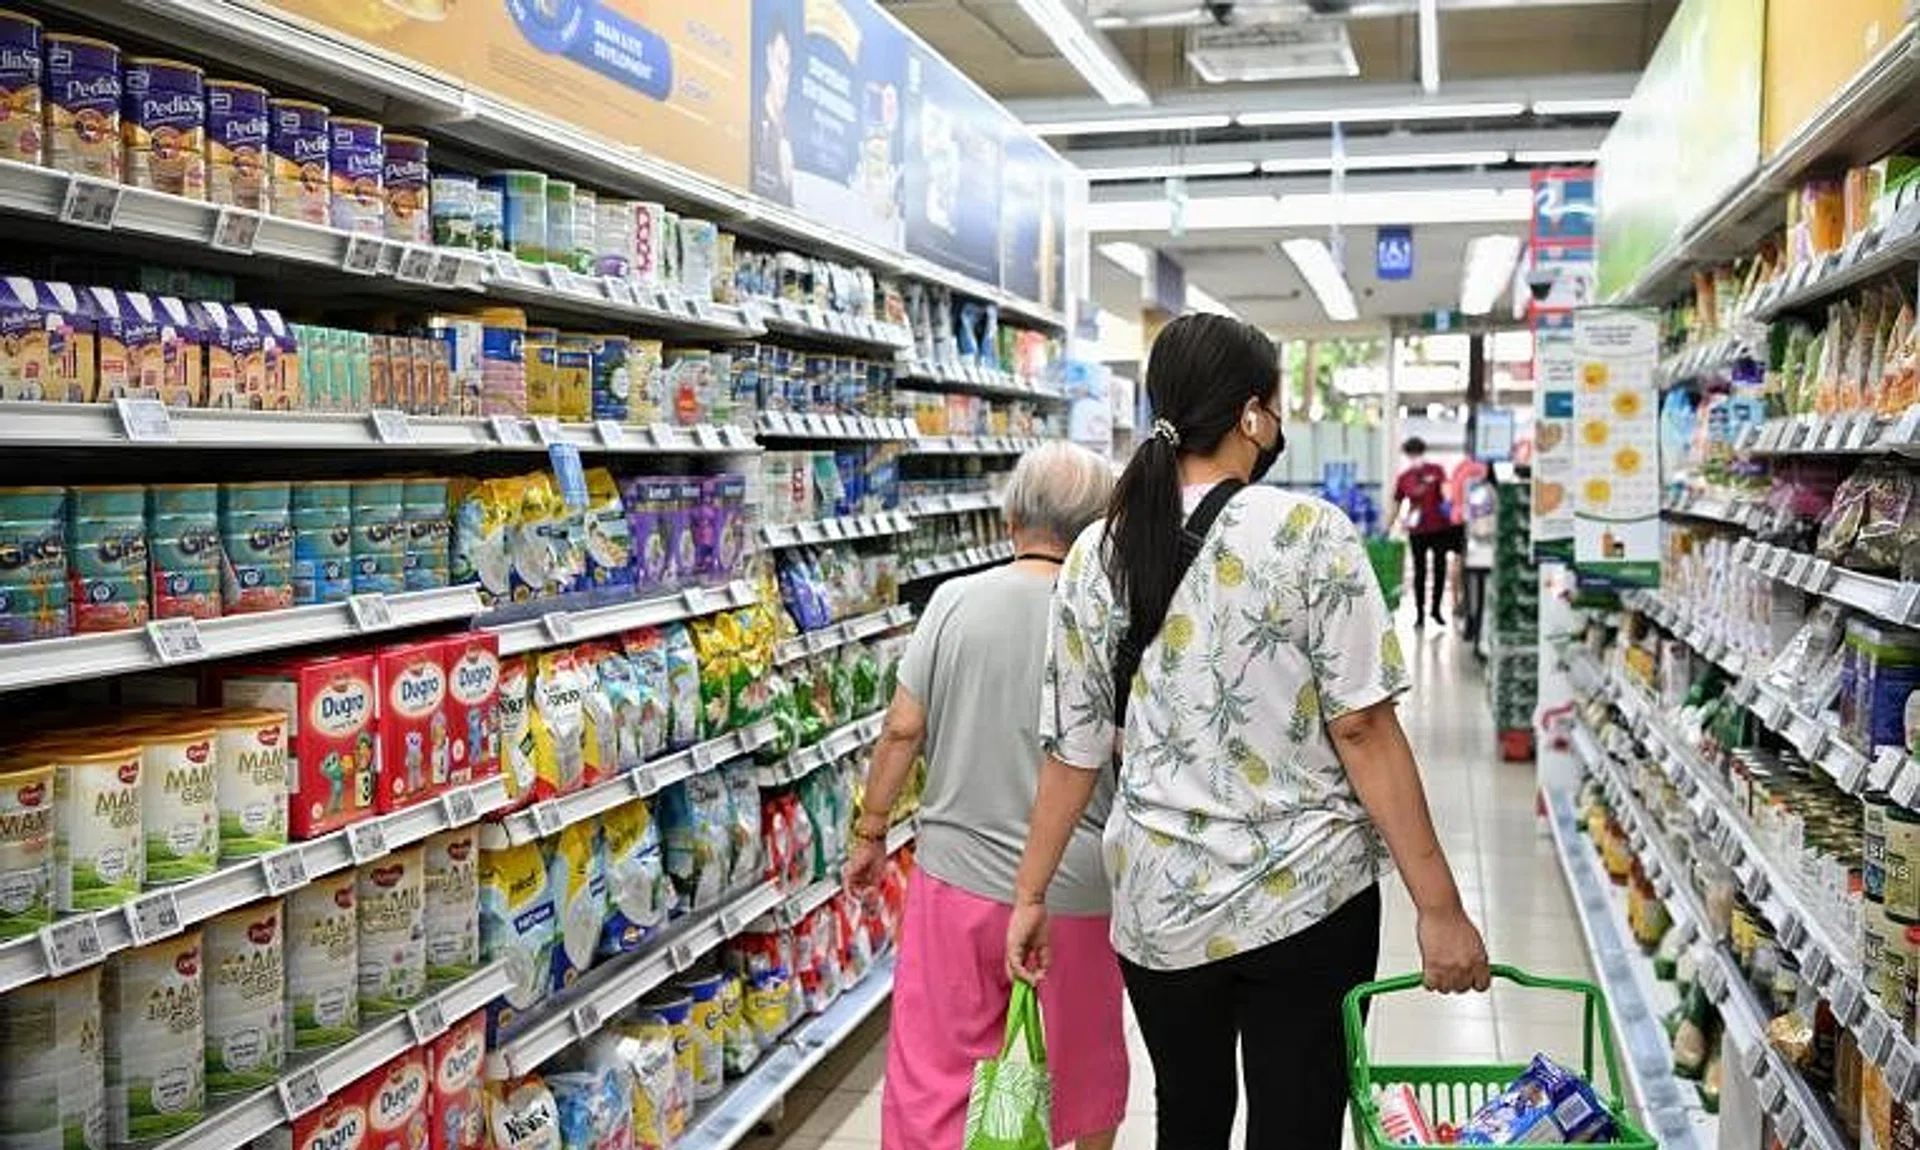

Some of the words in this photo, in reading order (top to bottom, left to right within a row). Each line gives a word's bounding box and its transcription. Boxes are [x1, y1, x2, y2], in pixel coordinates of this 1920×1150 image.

[401, 676, 439, 702] Dugro
[458, 665, 492, 688] Dugro
[322, 693, 364, 719] Dugro
[380, 1075, 419, 1114] Dugro
